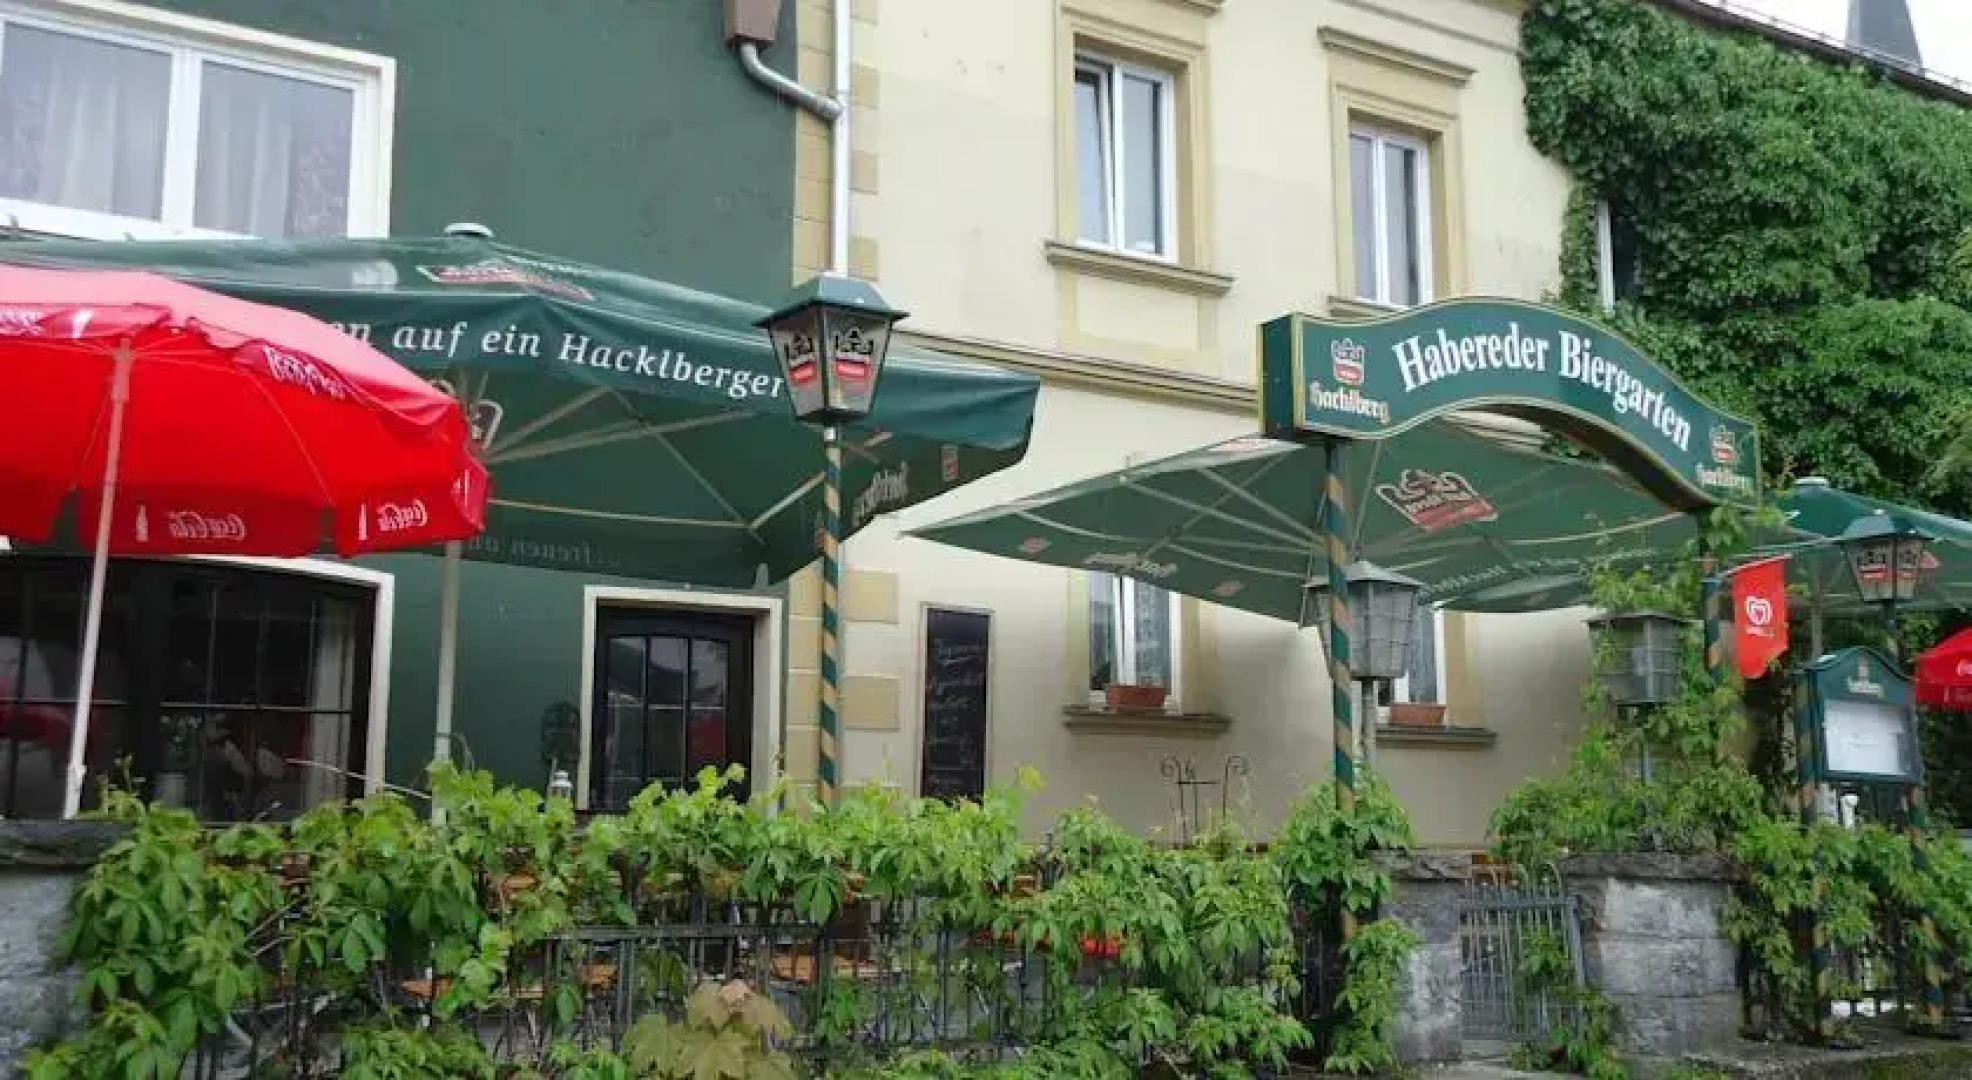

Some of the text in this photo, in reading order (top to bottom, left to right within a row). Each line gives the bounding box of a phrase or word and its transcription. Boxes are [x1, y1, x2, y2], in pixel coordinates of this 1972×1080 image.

[392, 322, 468, 357] auf
[481, 324, 541, 357] ein
[557, 333, 784, 399] Hacklberger
[1392, 322, 1690, 451] Habereder Biergarten
